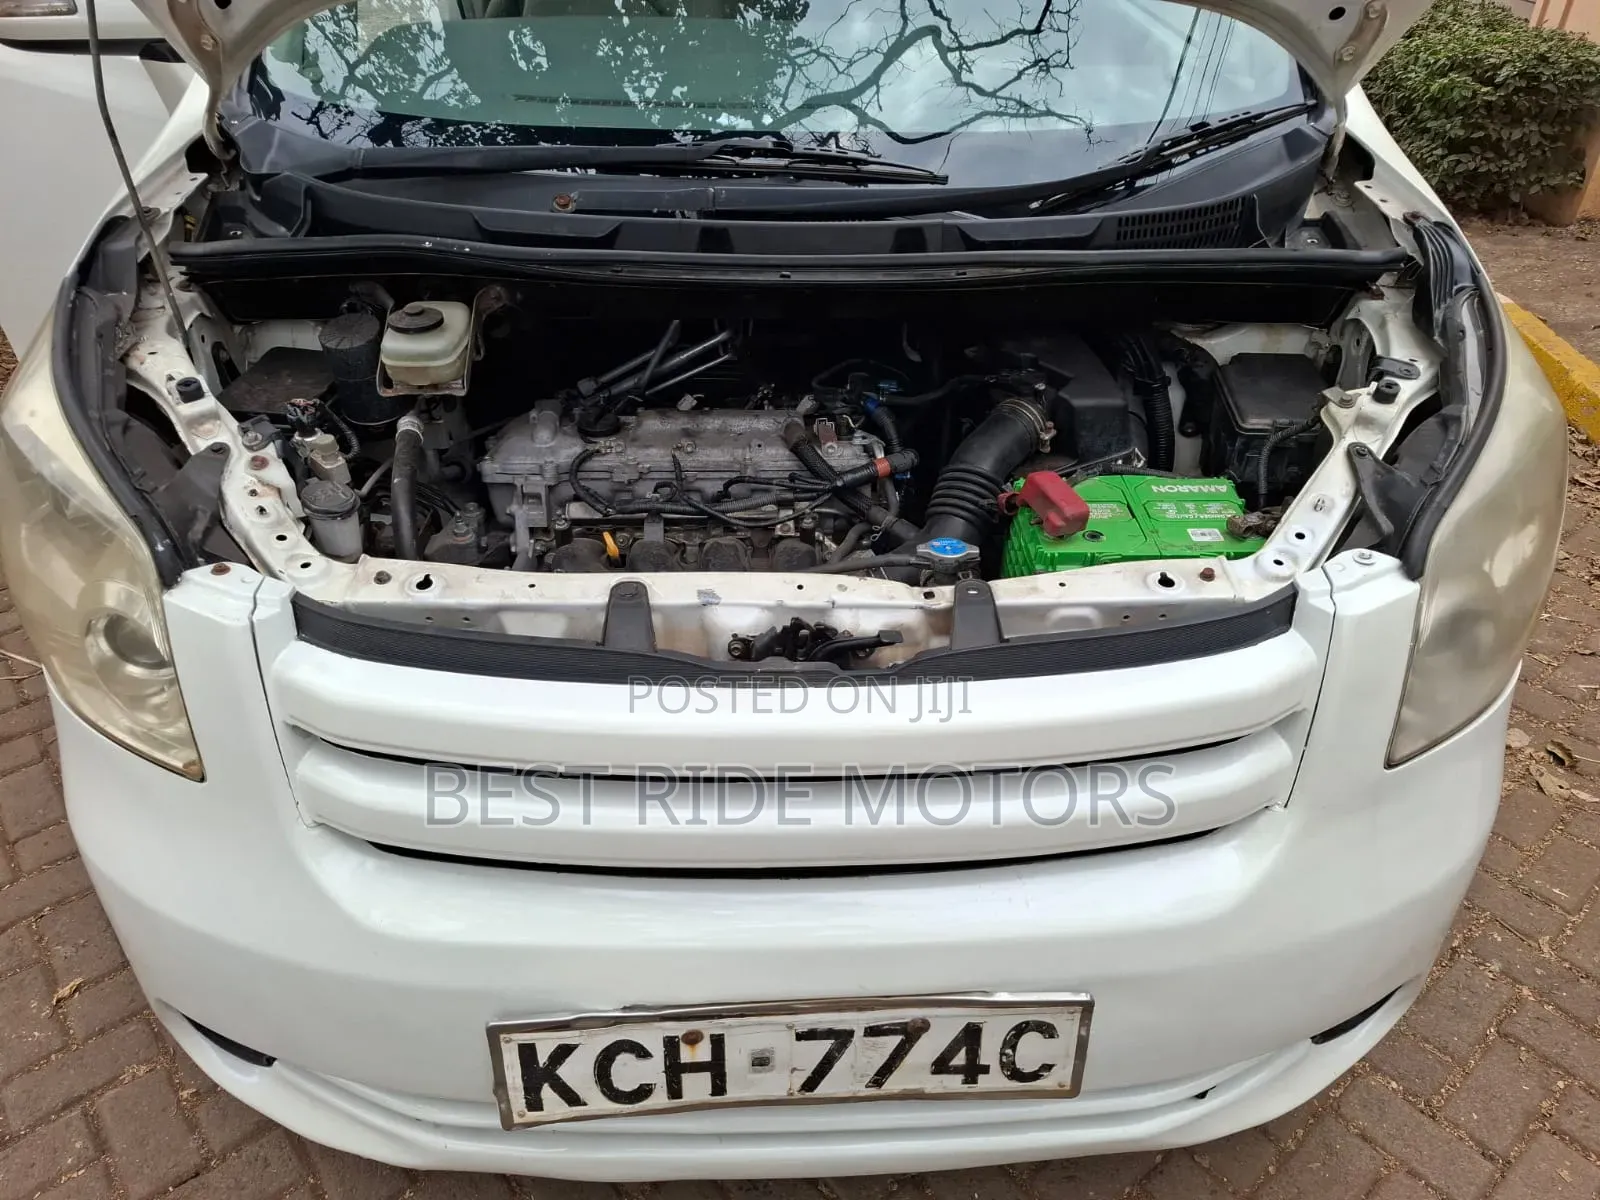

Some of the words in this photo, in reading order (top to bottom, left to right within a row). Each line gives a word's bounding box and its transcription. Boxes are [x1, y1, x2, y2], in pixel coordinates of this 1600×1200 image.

[1151, 484, 1227, 494] AMARON
[518, 1032, 727, 1112] KCH
[795, 1020, 1059, 1094] 774C
